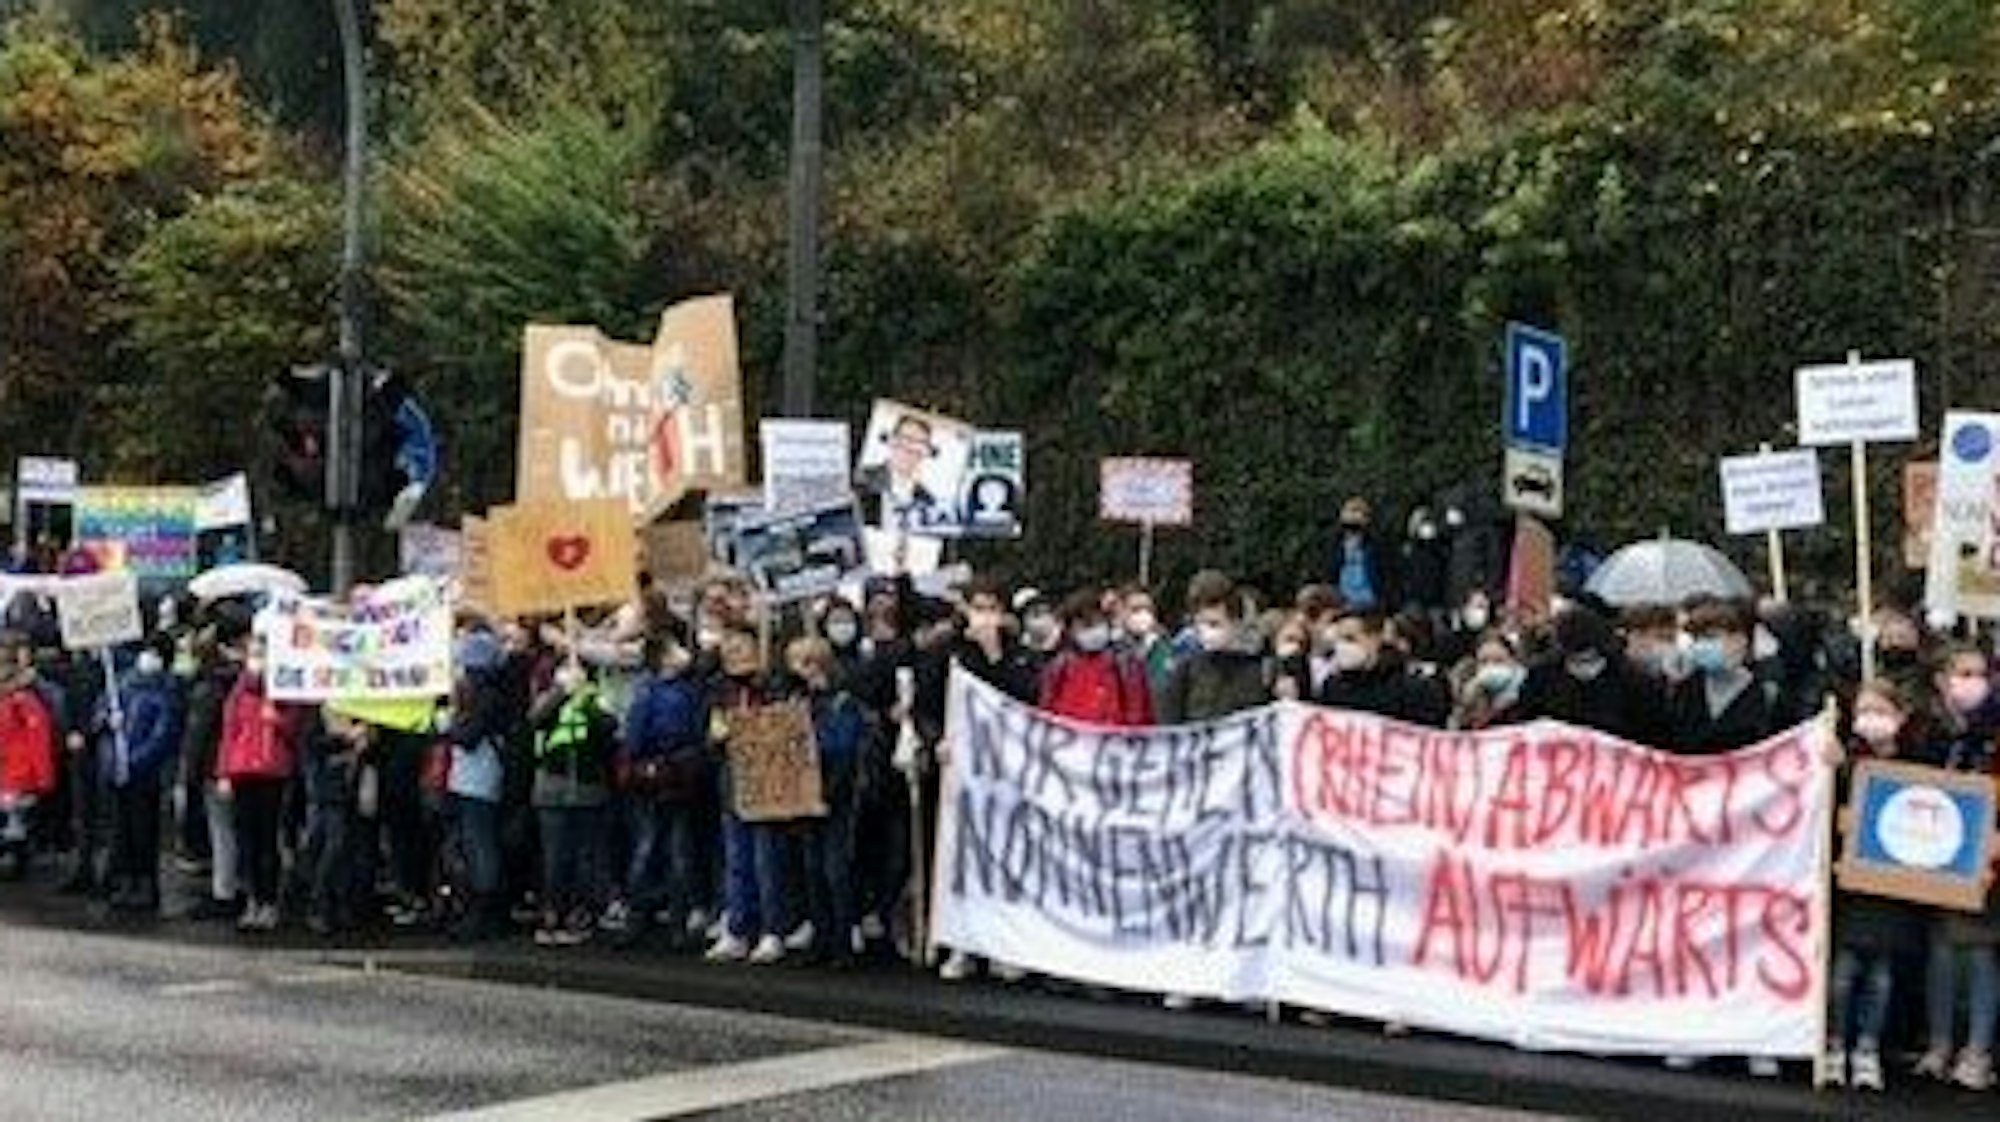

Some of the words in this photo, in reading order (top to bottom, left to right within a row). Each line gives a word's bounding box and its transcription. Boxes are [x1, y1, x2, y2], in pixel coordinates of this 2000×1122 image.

[1518, 343, 1552, 431] P
[964, 684, 1076, 802] WIR
[1092, 712, 1284, 826] GEHEN
[951, 786, 1391, 966] NONNENWERTH
